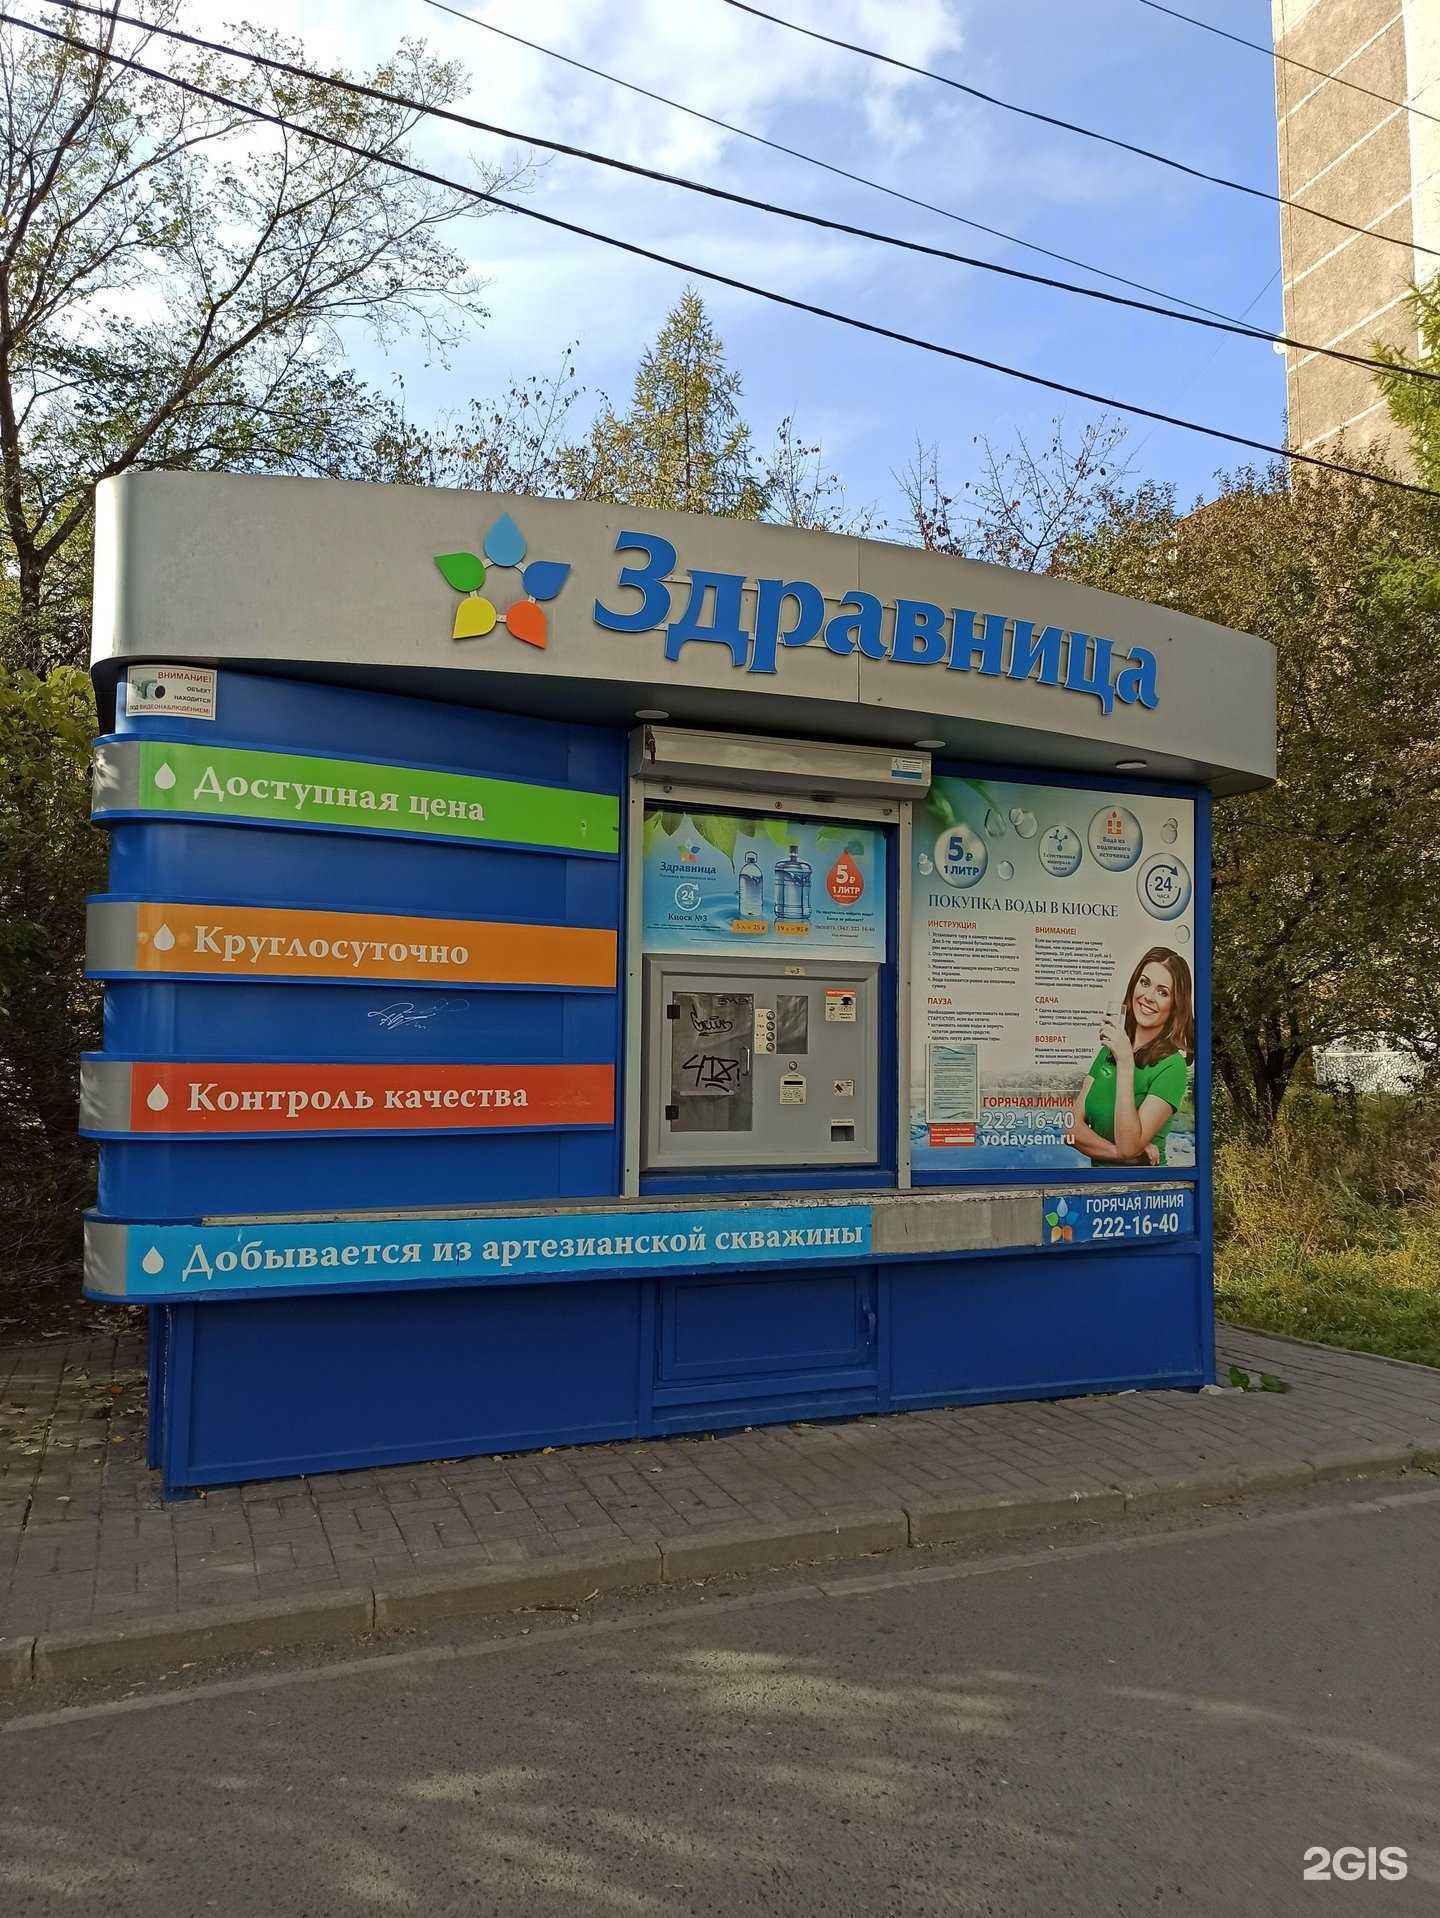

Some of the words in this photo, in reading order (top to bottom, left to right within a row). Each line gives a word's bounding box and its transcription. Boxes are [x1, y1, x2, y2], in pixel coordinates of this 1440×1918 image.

[593, 530, 1161, 716] Здравница
[157, 671, 212, 684] ВНИМАНИЕ!
[186, 686, 212, 695] ОБЪЕКТ
[174, 695, 212, 704] НАХОДИТСЯ
[193, 765, 398, 813] Доступная
[407, 795, 485, 825] цена
[660, 861, 717, 875] Здравница
[1155, 876, 1172, 892] 24
[681, 889, 695, 901] 24
[928, 894, 1001, 912] ПОКУПКА
[1005, 899, 1047, 914] ВОДЫ
[1051, 901, 1058, 914] В
[1062, 903, 1119, 918] КИОСКЕ
[667, 912, 693, 922] Киоск
[694, 913, 708, 923] №3
[928, 919, 977, 930] ИНСТРУКЦИЯ
[1035, 926, 1077, 936] ВНИМАНИЕ!
[194, 925, 470, 969] Круглосуточно
[928, 997, 952, 1006] ПАУЗА
[1035, 996, 1059, 1005] СДАЧА
[1035, 1035, 1067, 1044] ВОЗВРАТ
[187, 1082, 374, 1118] Контроль
[382, 1084, 529, 1110] качества
[983, 1096, 1033, 1108] ГОРЯЧАЯ
[1036, 1097, 1074, 1109] ЛИНИЯ
[982, 1110, 1076, 1130] 222-16-40
[982, 1131, 1076, 1146] vodavsem.ru
[1086, 1196, 1142, 1214] ГОРЯЧАЯ
[1144, 1193, 1185, 1211] ЛИНИЯ
[1092, 1212, 1179, 1239] 222-16-40
[182, 1240, 423, 1283] Добывается
[432, 1241, 473, 1263] из
[481, 1226, 708, 1269] артезианской
[714, 1225, 865, 1252] скважины
